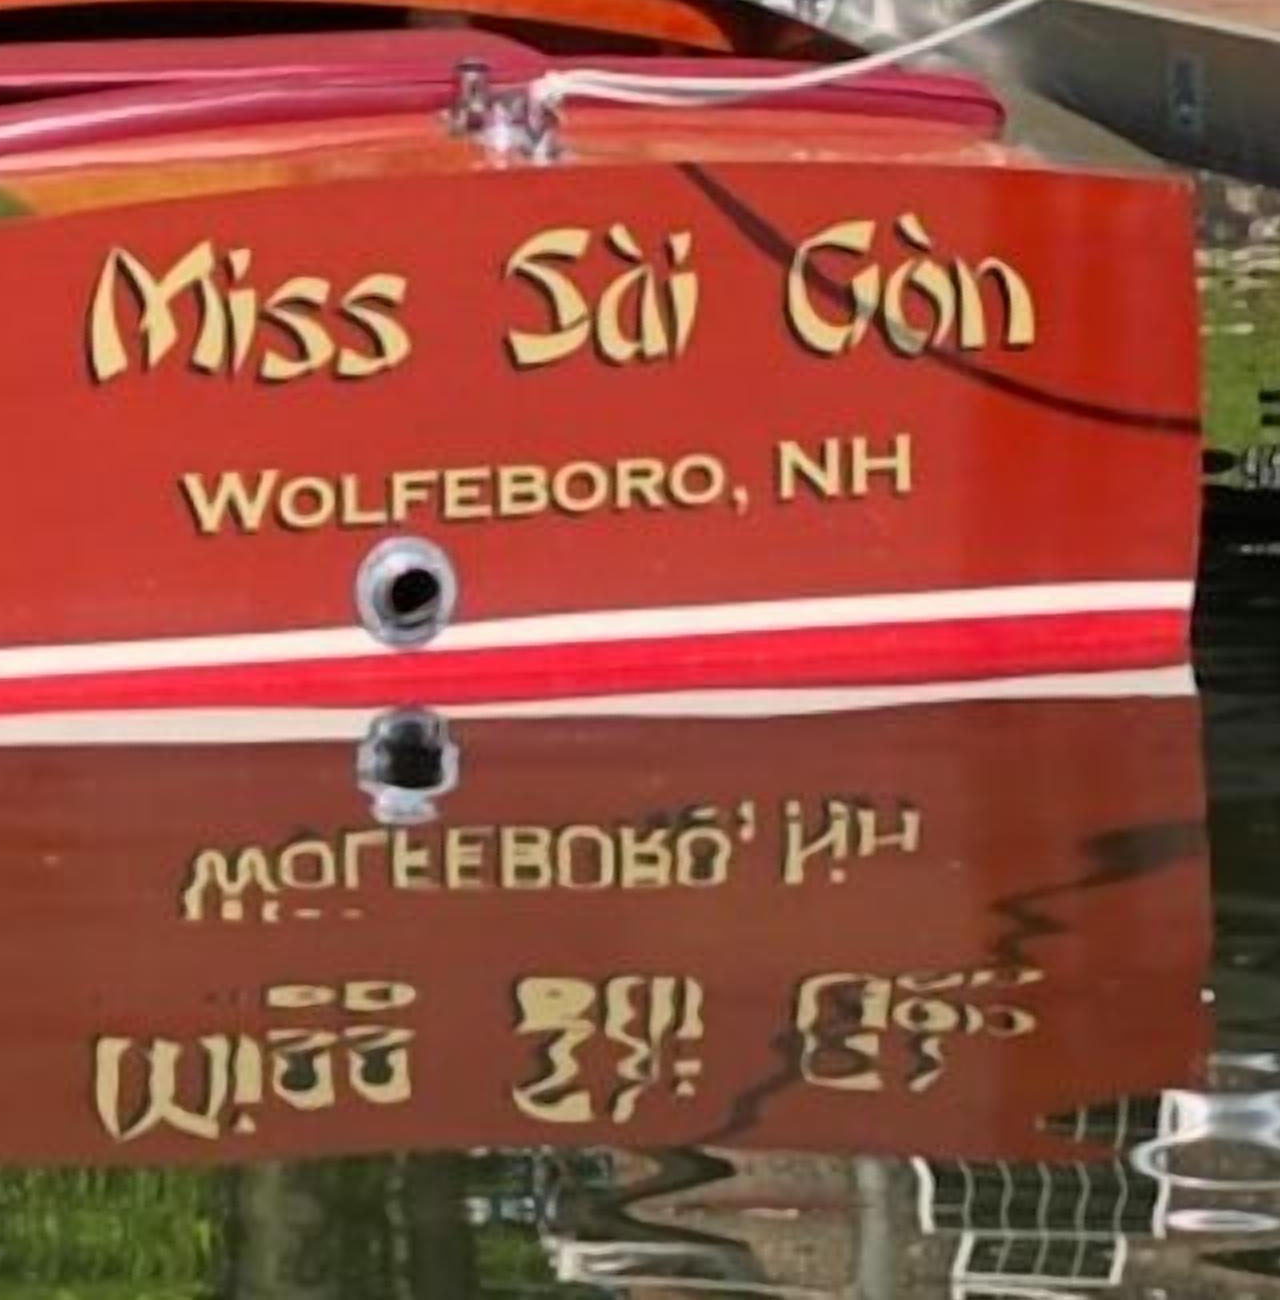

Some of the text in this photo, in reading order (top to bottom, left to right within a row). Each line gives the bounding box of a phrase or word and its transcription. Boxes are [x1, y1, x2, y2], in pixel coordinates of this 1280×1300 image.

[88, 214, 1036, 384] Miss Sài Gòn
[180, 434, 914, 535] WOLFEBORO, NH
